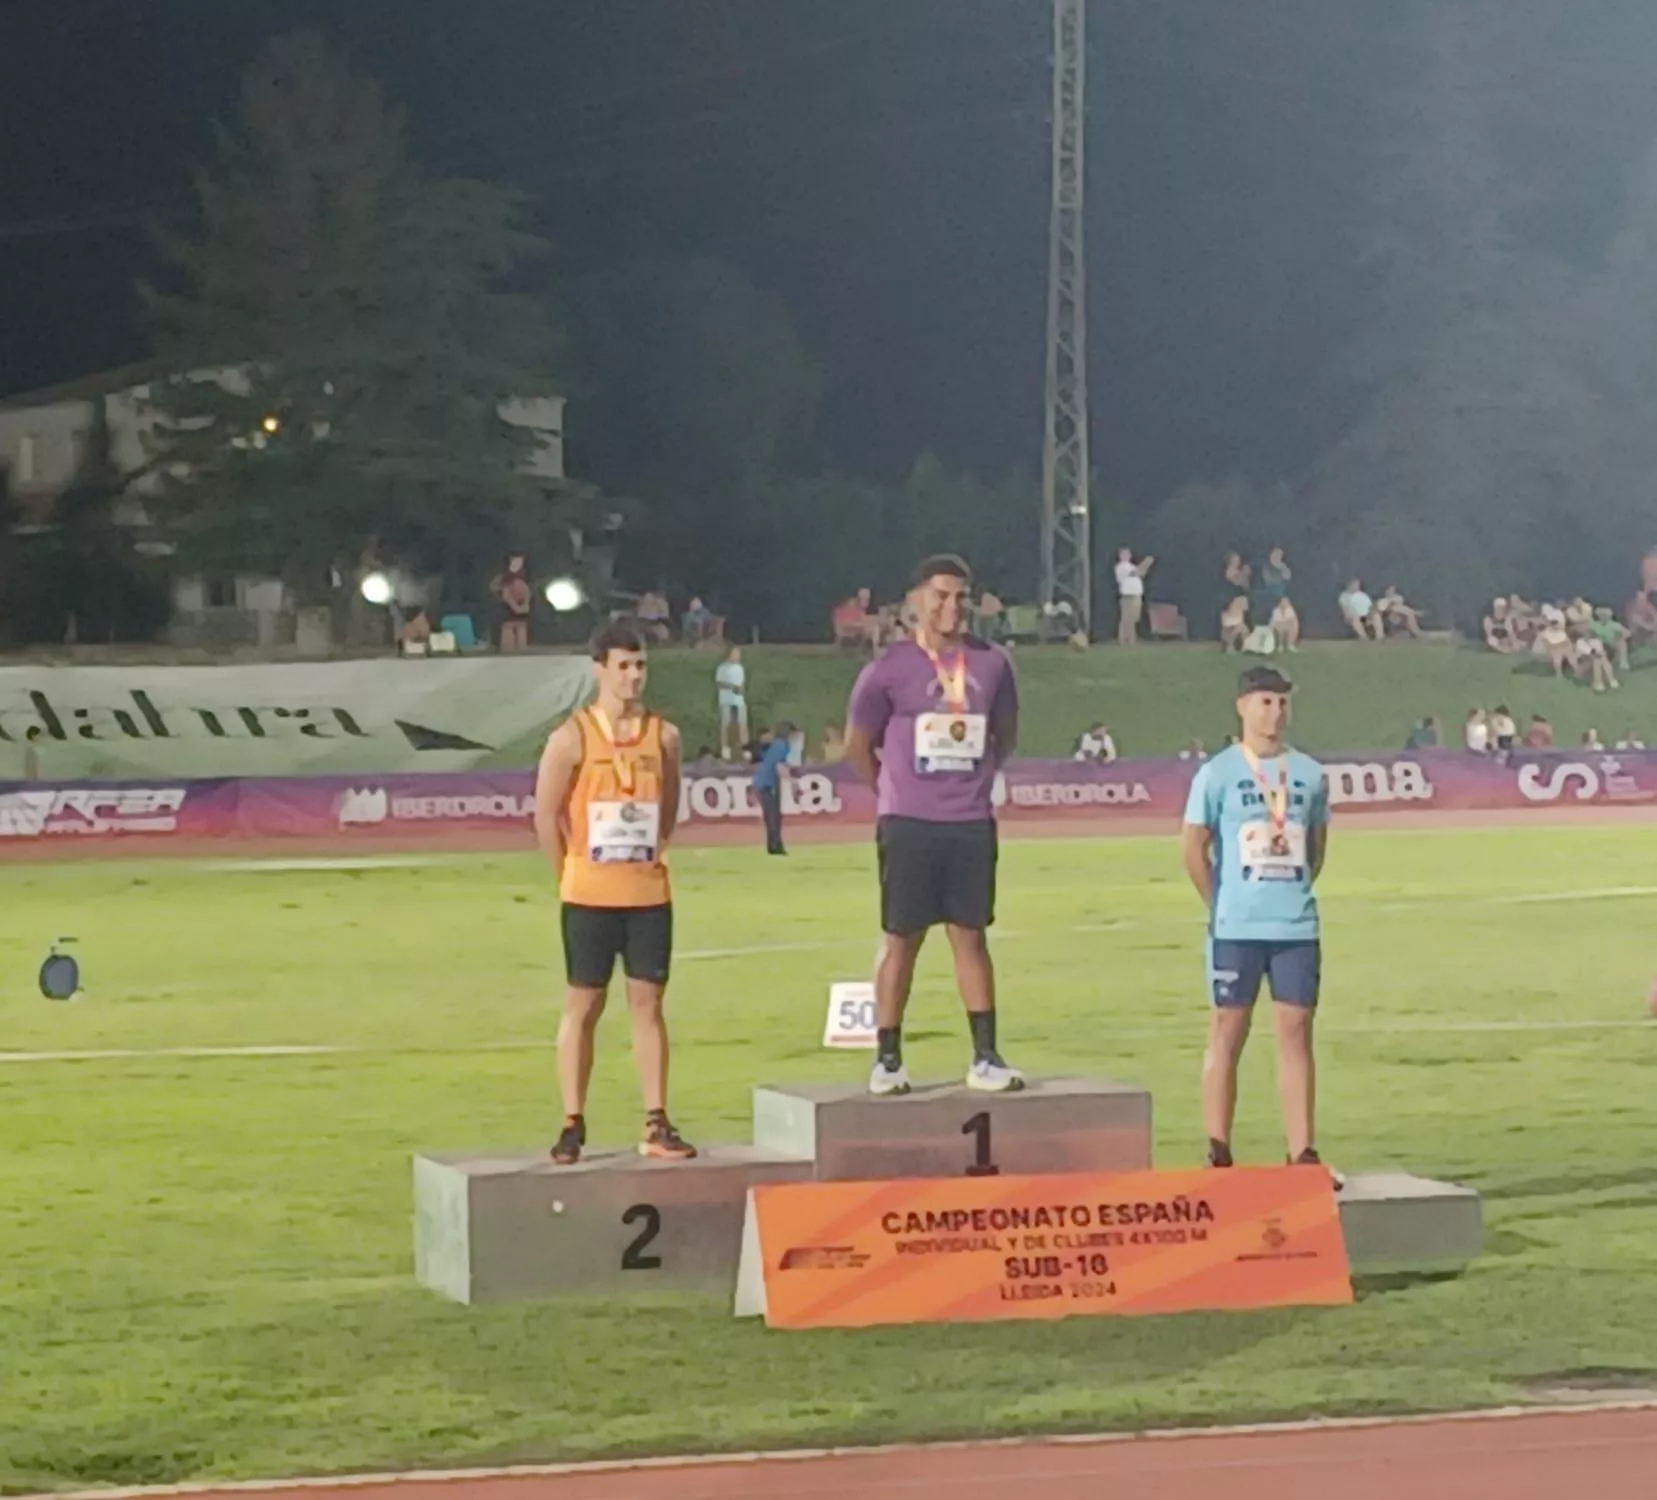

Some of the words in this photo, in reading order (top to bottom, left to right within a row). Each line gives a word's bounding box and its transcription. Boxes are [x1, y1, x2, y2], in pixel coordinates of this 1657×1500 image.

[838, 999, 878, 1031] 50
[961, 1111, 999, 1177] 1
[620, 1203, 662, 1270] 2
[881, 1204, 1091, 1235] CAMPEONATO
[1098, 1195, 1215, 1226] ESPAÑA
